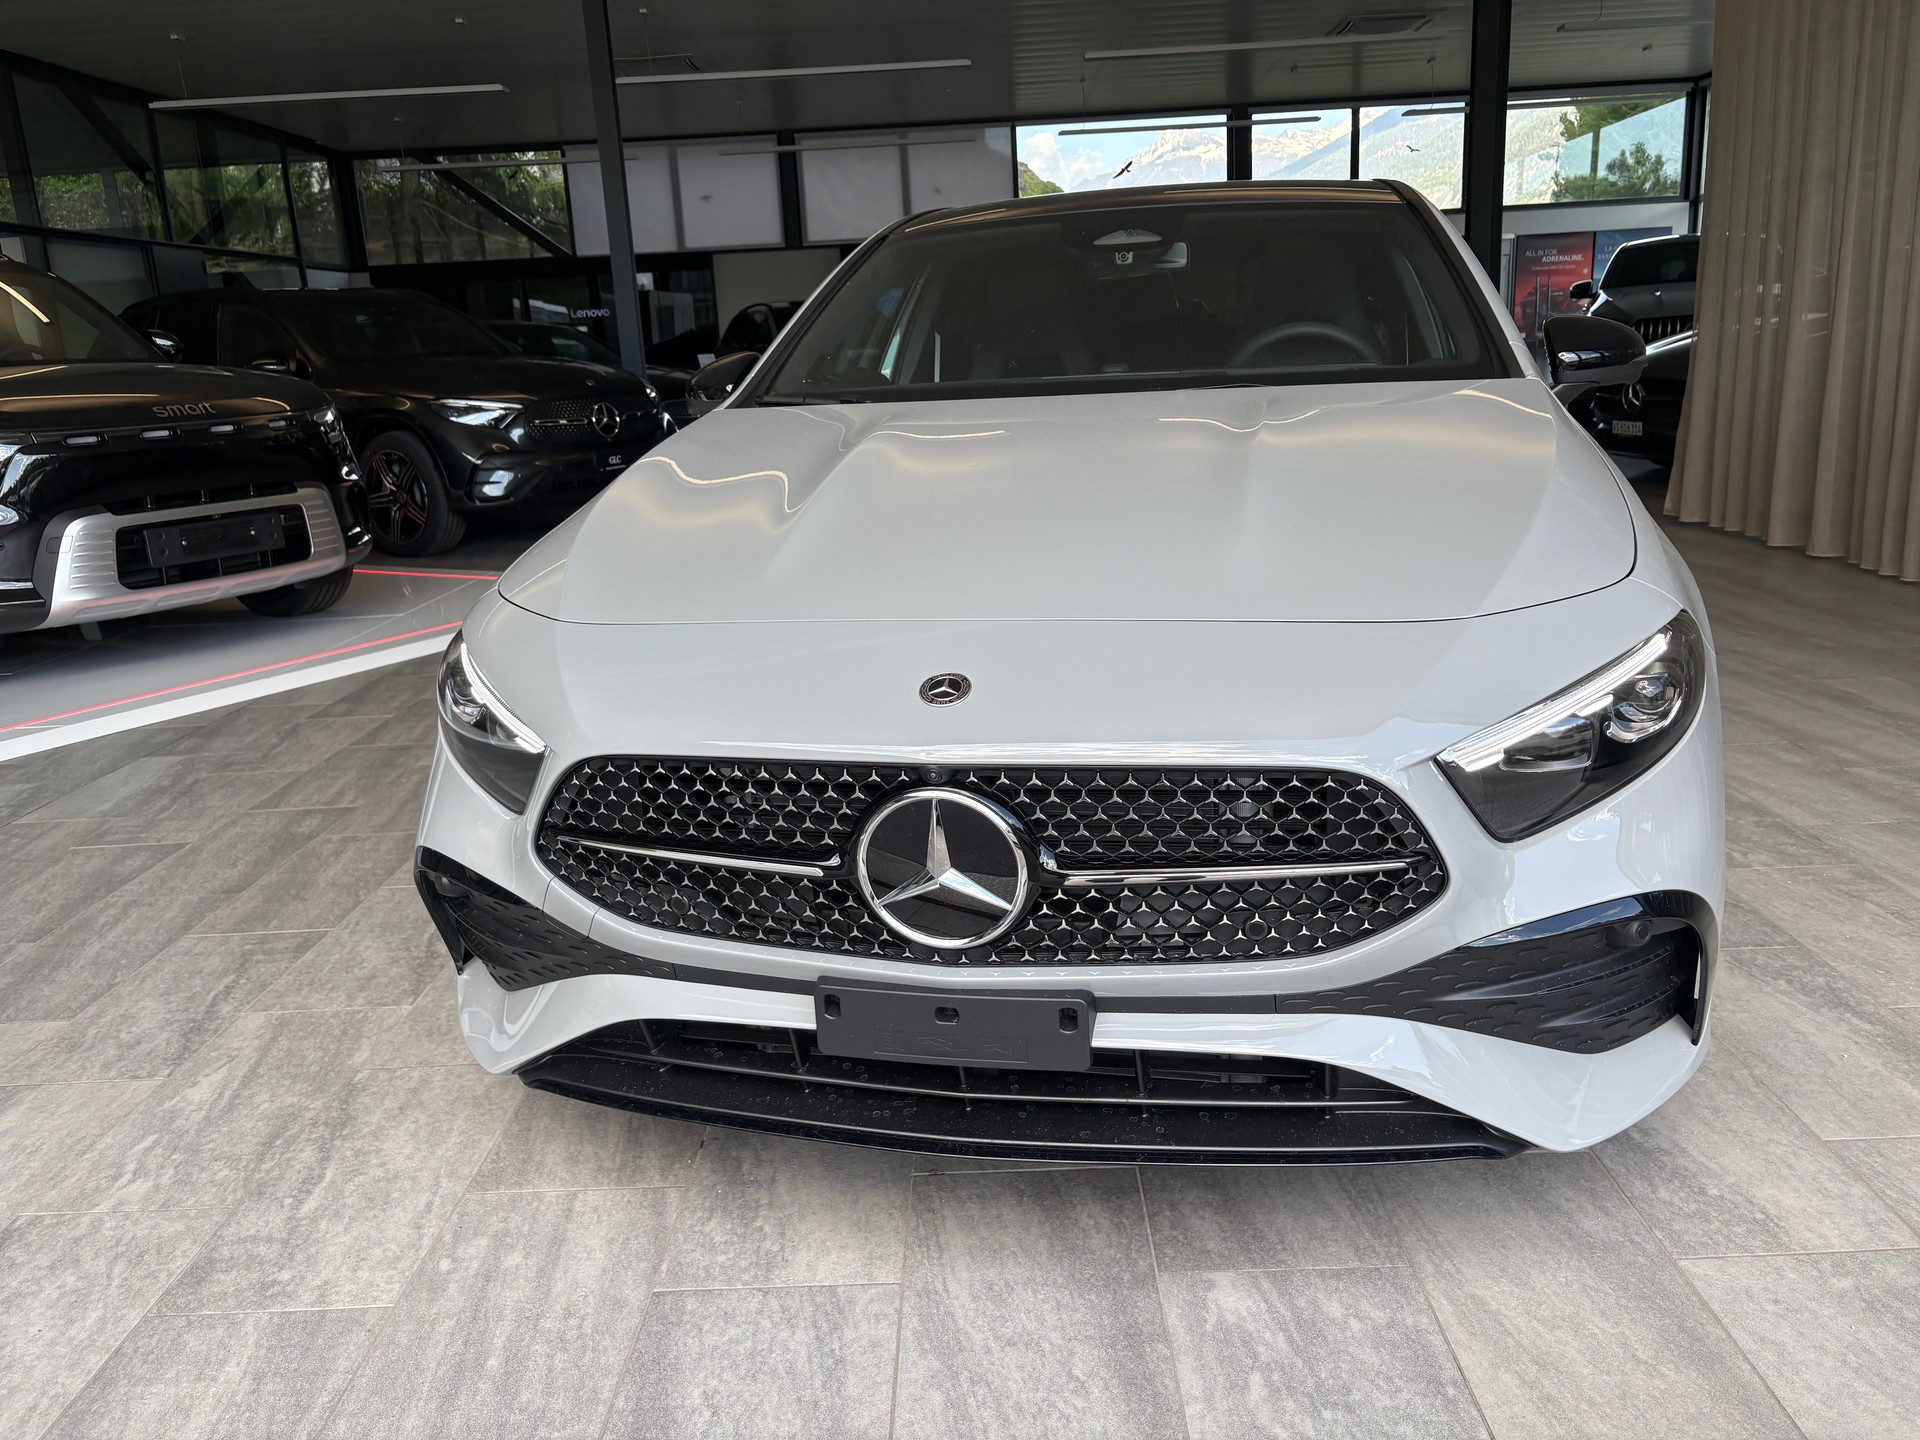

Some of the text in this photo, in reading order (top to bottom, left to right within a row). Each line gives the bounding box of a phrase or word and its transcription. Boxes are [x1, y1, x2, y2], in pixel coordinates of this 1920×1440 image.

[1525, 249, 1536, 257] ALL
[1544, 248, 1558, 256] FOR
[1541, 254, 1585, 263] ADRENALINE.
[570, 308, 610, 318] Lenovo
[151, 401, 217, 417] smart
